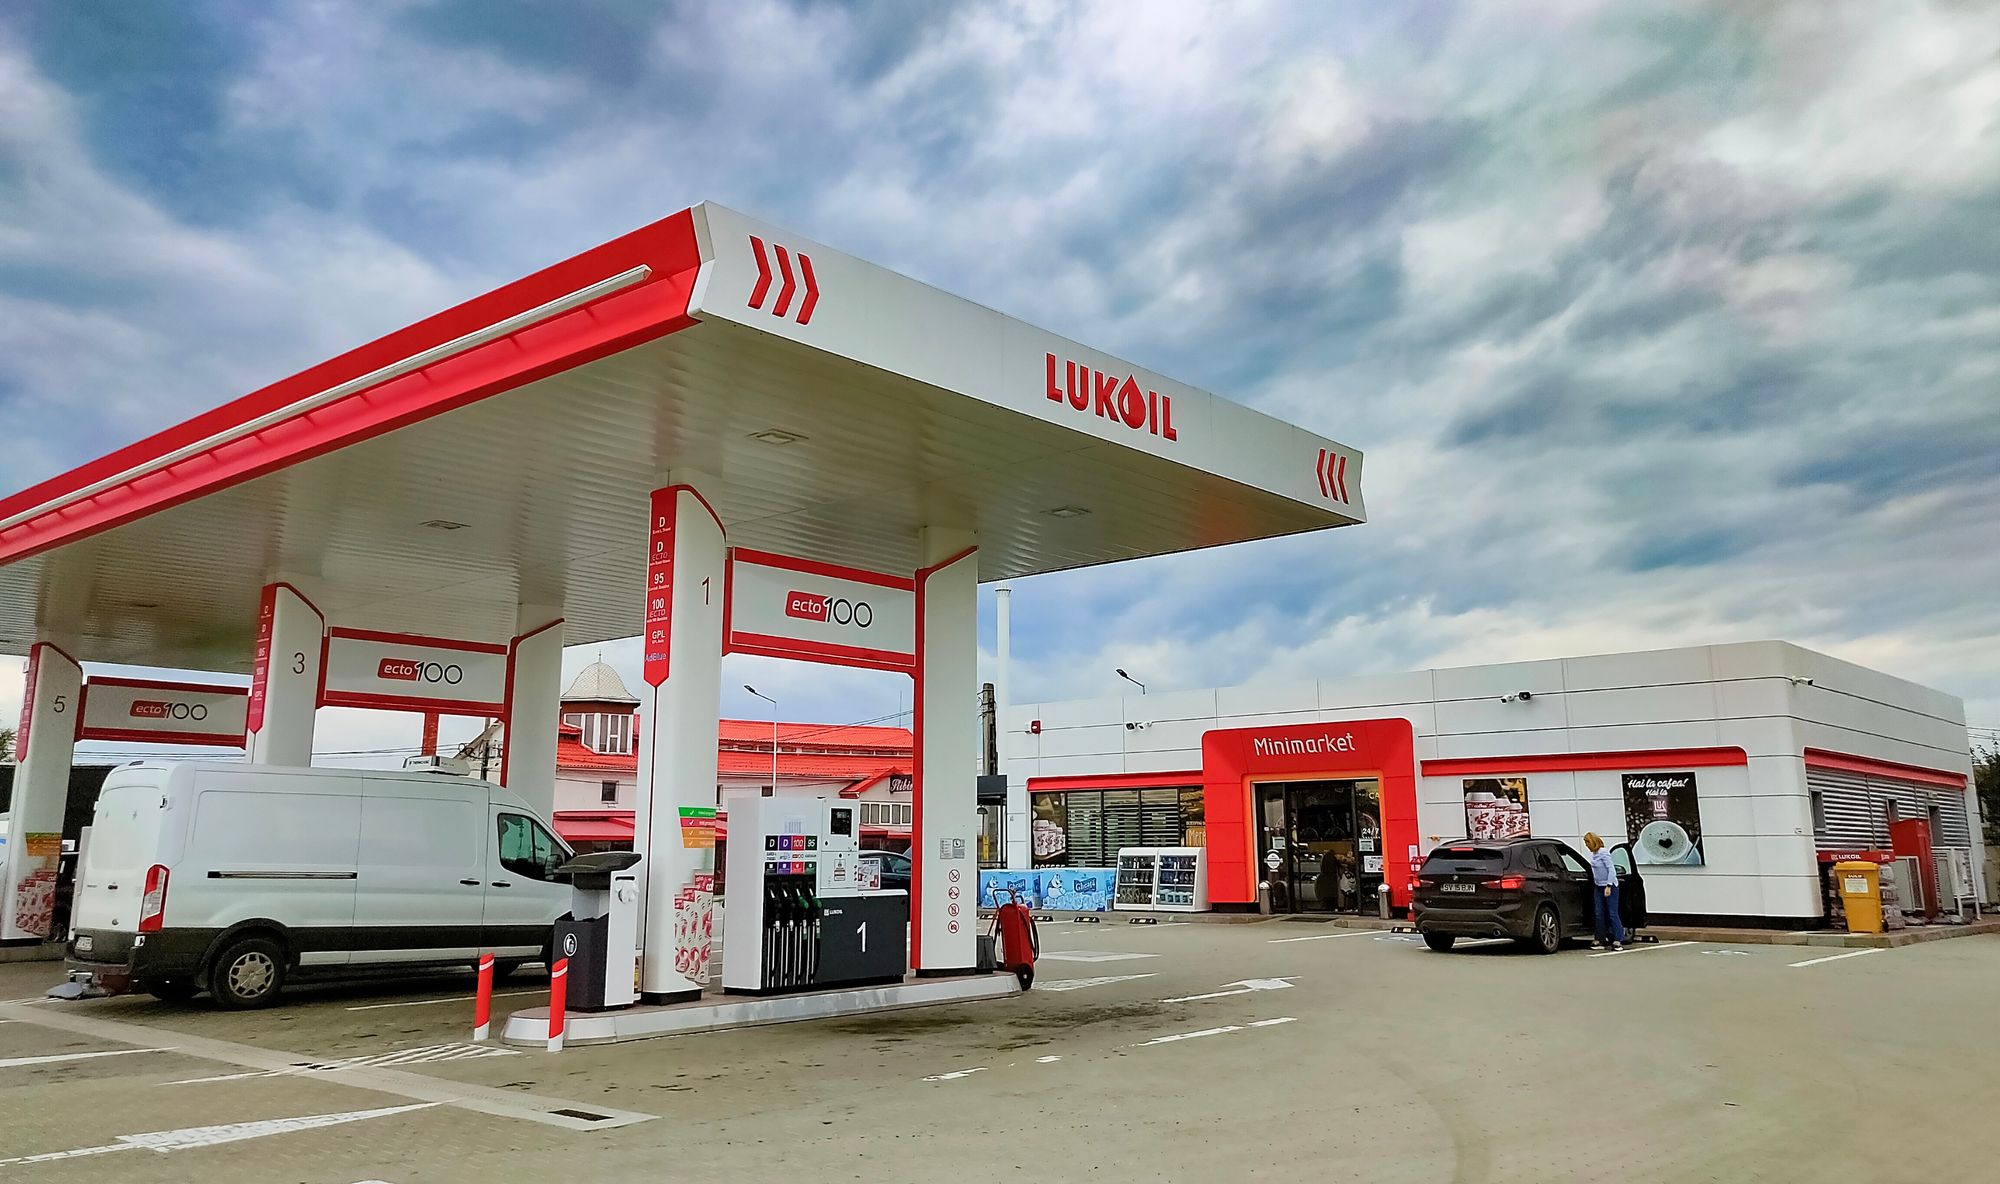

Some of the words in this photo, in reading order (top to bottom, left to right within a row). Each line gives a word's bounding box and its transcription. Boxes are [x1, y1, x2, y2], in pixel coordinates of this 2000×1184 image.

[1046, 352, 1177, 442] LUKOIL
[659, 516, 666, 527] D
[657, 541, 664, 552] D
[652, 552, 668, 561] ECTO
[654, 573, 664, 584] 95
[701, 576, 710, 606] 1
[652, 597, 665, 610] 100
[649, 609, 666, 618] ECTO
[652, 630, 666, 640] GPL
[292, 652, 305, 675] 3
[53, 695, 67, 713] 5
[1253, 732, 1356, 756] Minimarket
[1628, 779, 1645, 789] Hai
[1646, 778, 1656, 788] la
[1657, 778, 1689, 789] cafea!
[1362, 827, 1380, 836] 24/7
[769, 839, 775, 848] D
[782, 839, 789, 848] D
[793, 839, 804, 848] 100
[807, 839, 816, 848] 95
[856, 921, 866, 953] 1
